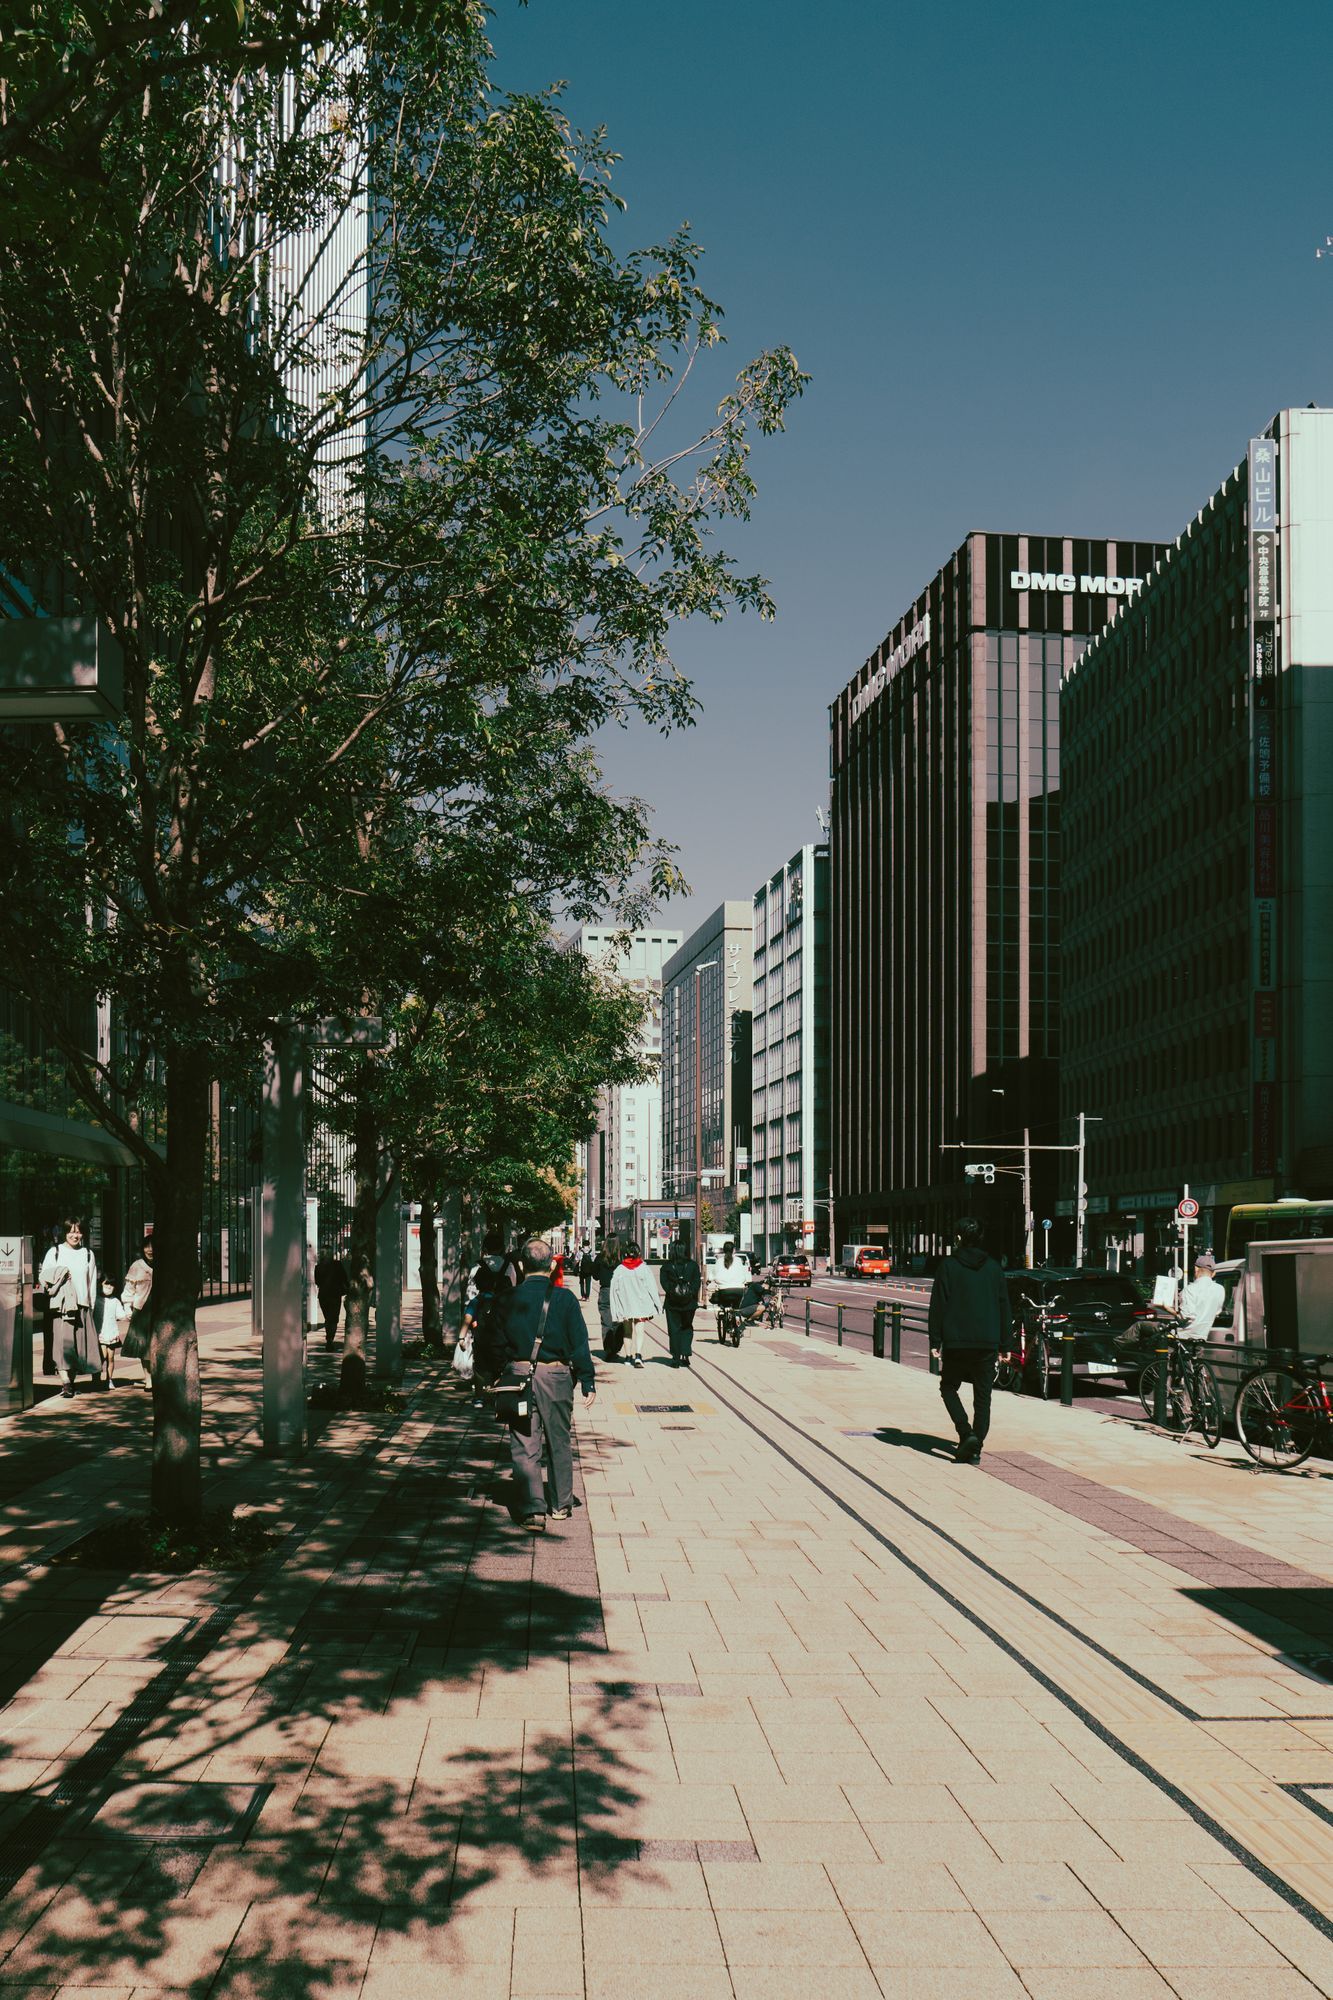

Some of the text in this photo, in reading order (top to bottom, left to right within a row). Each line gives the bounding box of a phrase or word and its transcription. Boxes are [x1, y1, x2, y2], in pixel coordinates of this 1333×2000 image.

[1255, 447, 1271, 522] 桑山ビル
[1010, 570, 1076, 593] DMG
[852, 612, 931, 725] DMG MORI
